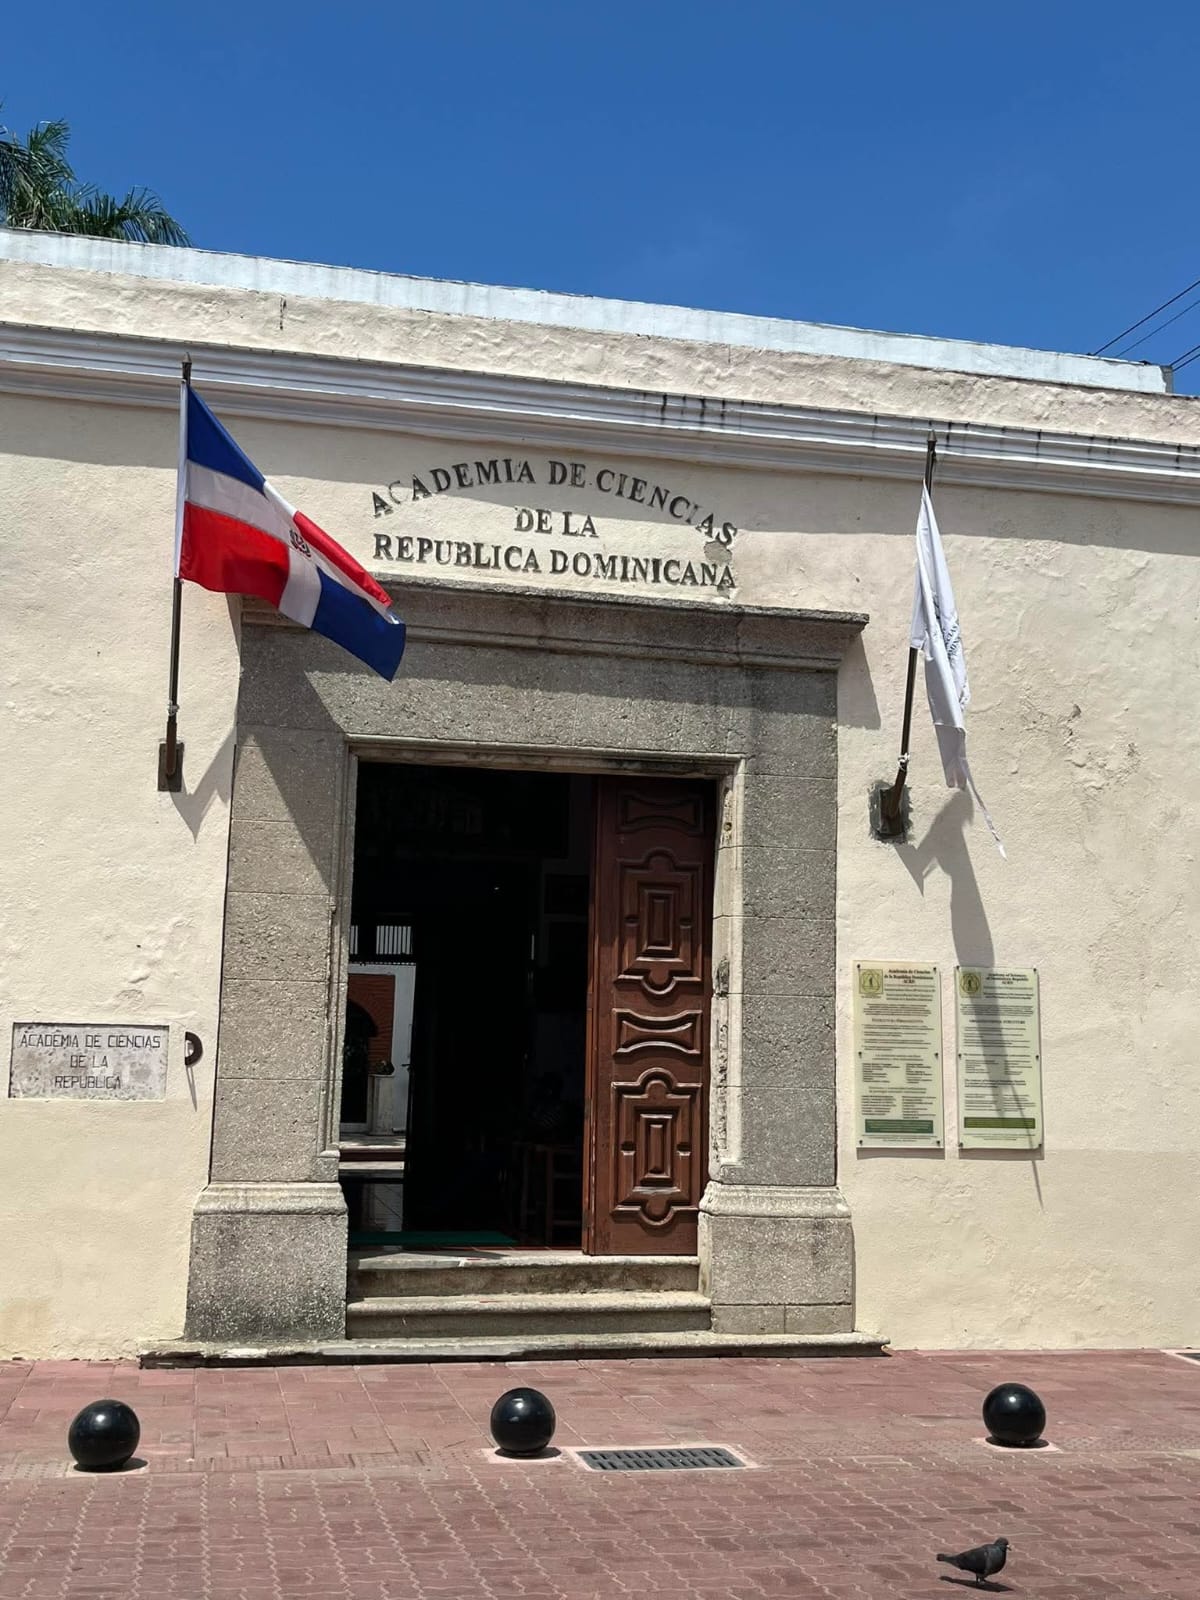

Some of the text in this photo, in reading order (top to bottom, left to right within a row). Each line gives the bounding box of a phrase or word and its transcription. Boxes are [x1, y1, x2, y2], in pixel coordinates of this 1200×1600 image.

[371, 458, 738, 546] ACADEMIA DE CIENCIAS
[514, 506, 599, 538] DE LA
[373, 533, 736, 589] REPUBLICA DOMINICANA
[19, 1034, 161, 1049] ACADEMIA DE CIENCIAS
[70, 1055, 109, 1069] DE LA
[55, 1075, 121, 1090] REPUBLICA
